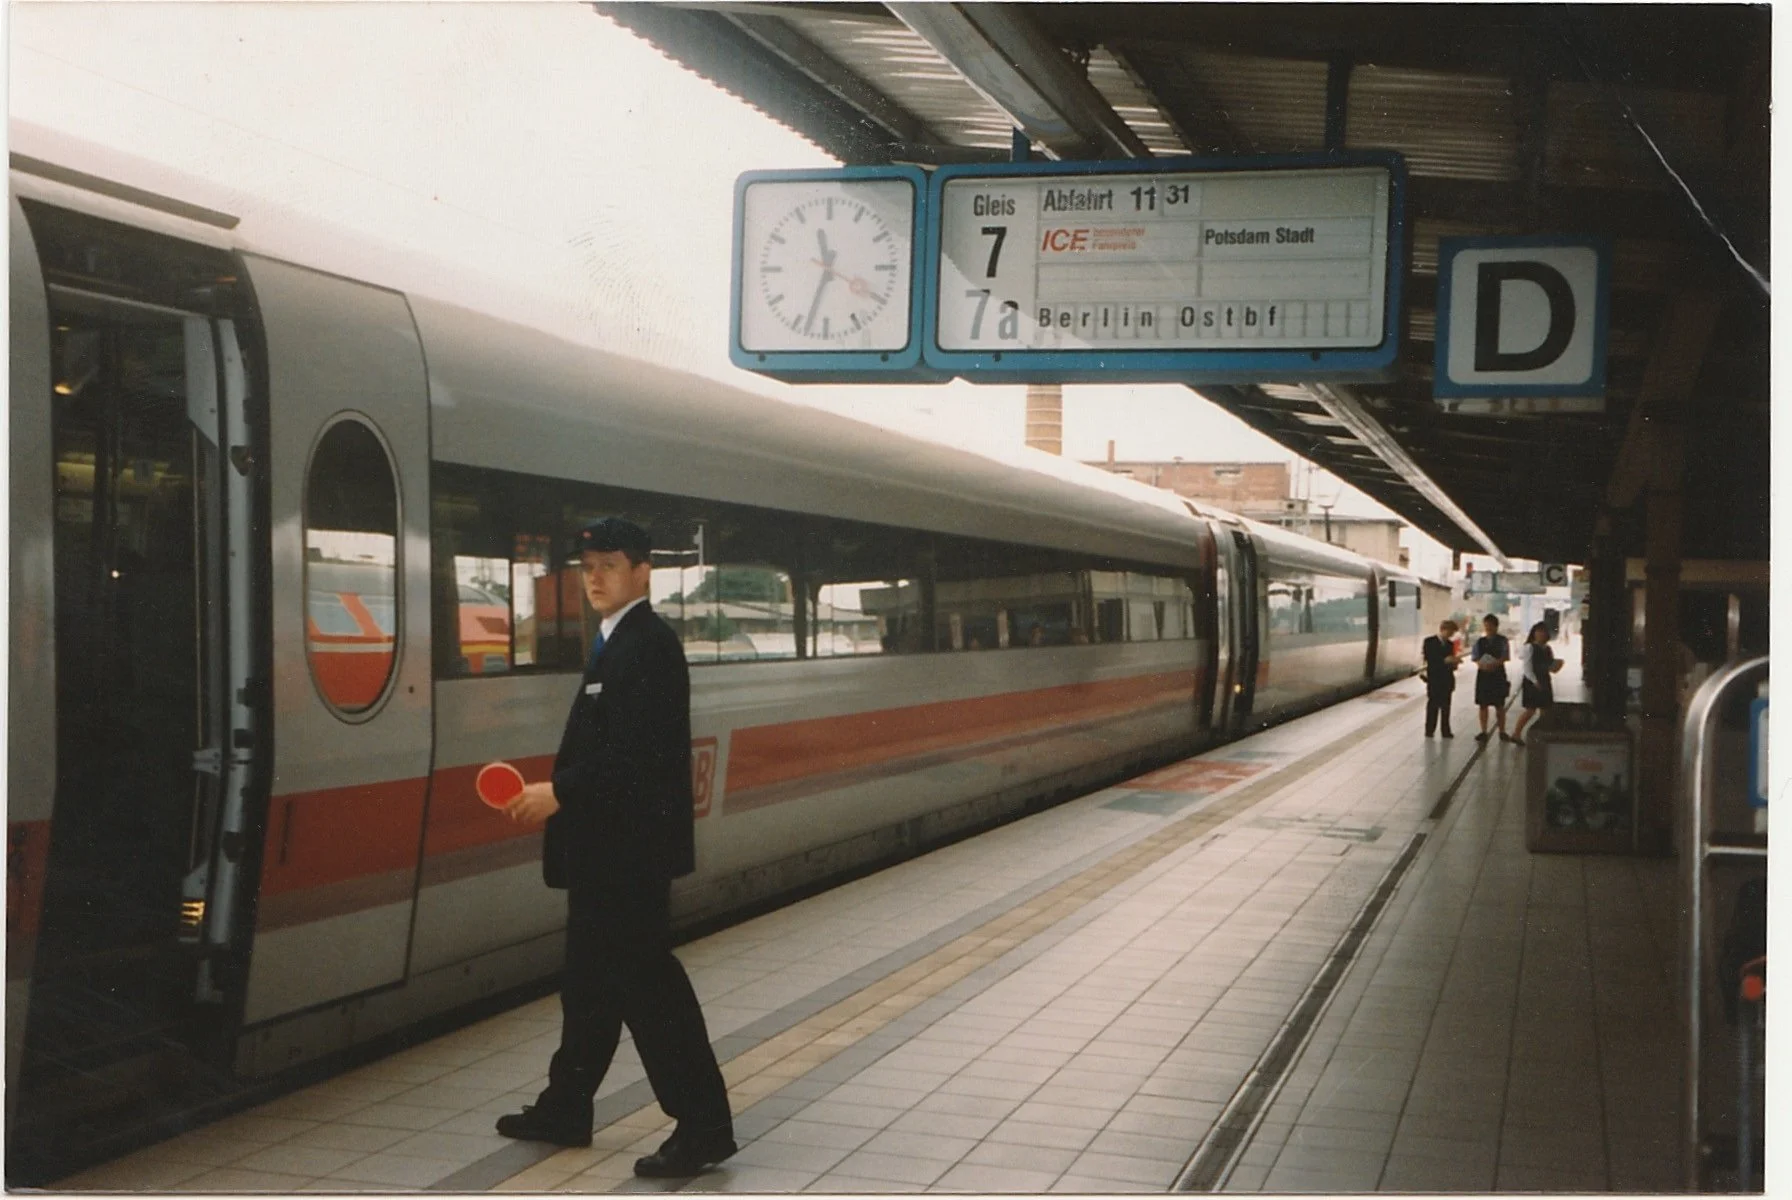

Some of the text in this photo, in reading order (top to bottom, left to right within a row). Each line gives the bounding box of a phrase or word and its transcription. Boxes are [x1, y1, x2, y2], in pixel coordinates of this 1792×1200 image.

[973, 195, 1016, 216] Gleis
[1043, 185, 1190, 211] Abfahrt 11 31
[1041, 229, 1089, 252] ICE
[1205, 226, 1315, 245] Potsdam Stadt
[981, 226, 1007, 278] 7
[965, 289, 1019, 340] 7a
[1038, 305, 1277, 328] Berlin Ostbf
[1474, 261, 1576, 372] D
[1546, 566, 1563, 584] C
